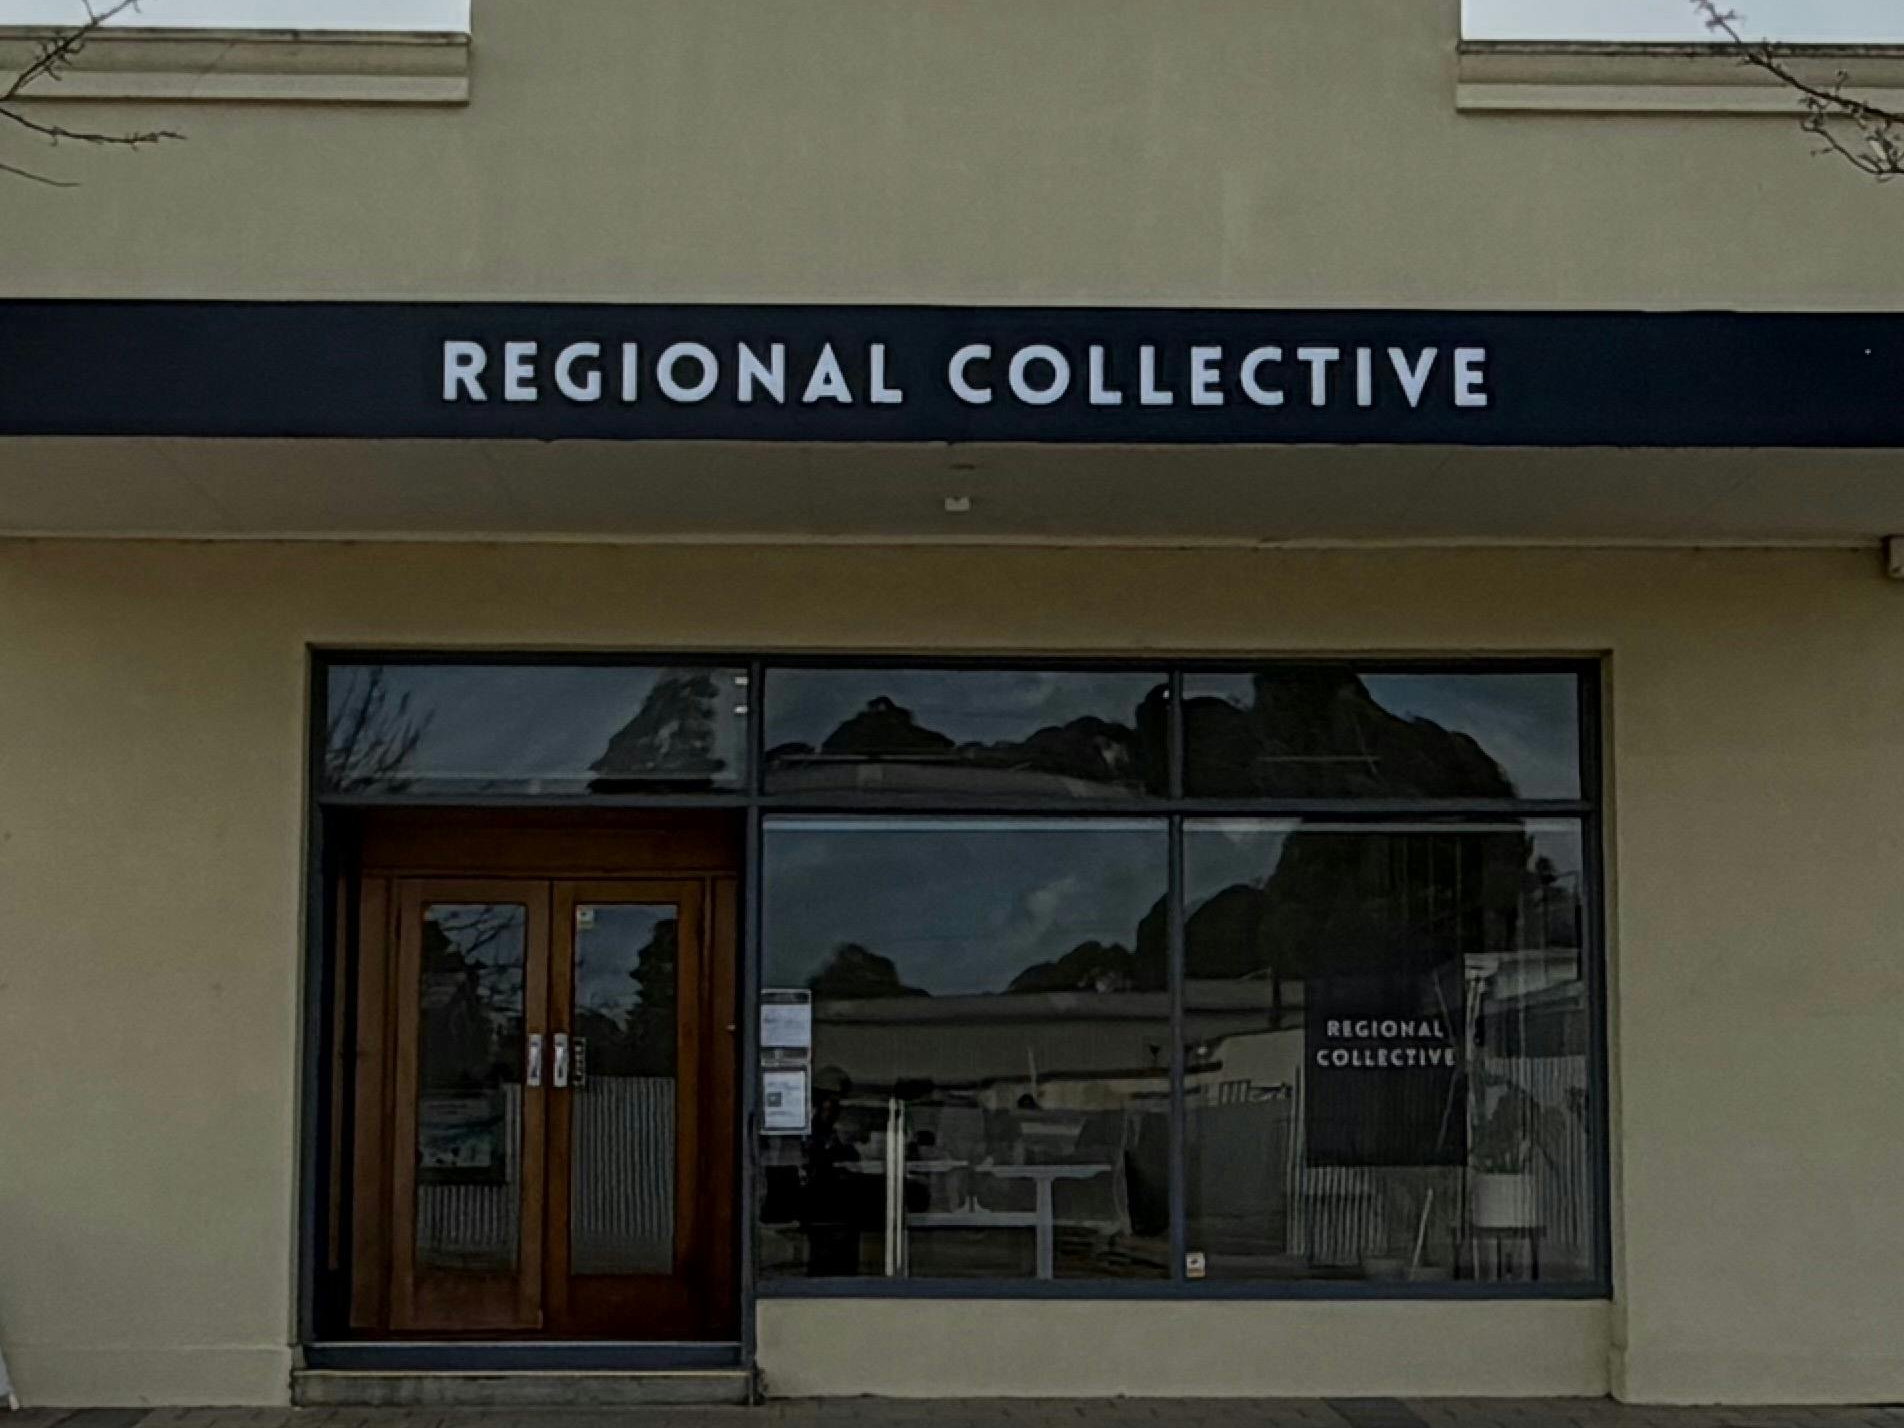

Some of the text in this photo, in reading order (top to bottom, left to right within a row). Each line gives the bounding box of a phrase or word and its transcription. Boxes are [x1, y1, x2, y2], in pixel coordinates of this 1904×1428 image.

[442, 339, 1489, 409] REGIONAL COLLECTIVE
[1326, 1019, 1445, 1039] REGIONAL
[1315, 1047, 1457, 1067] COLLECTIVE
